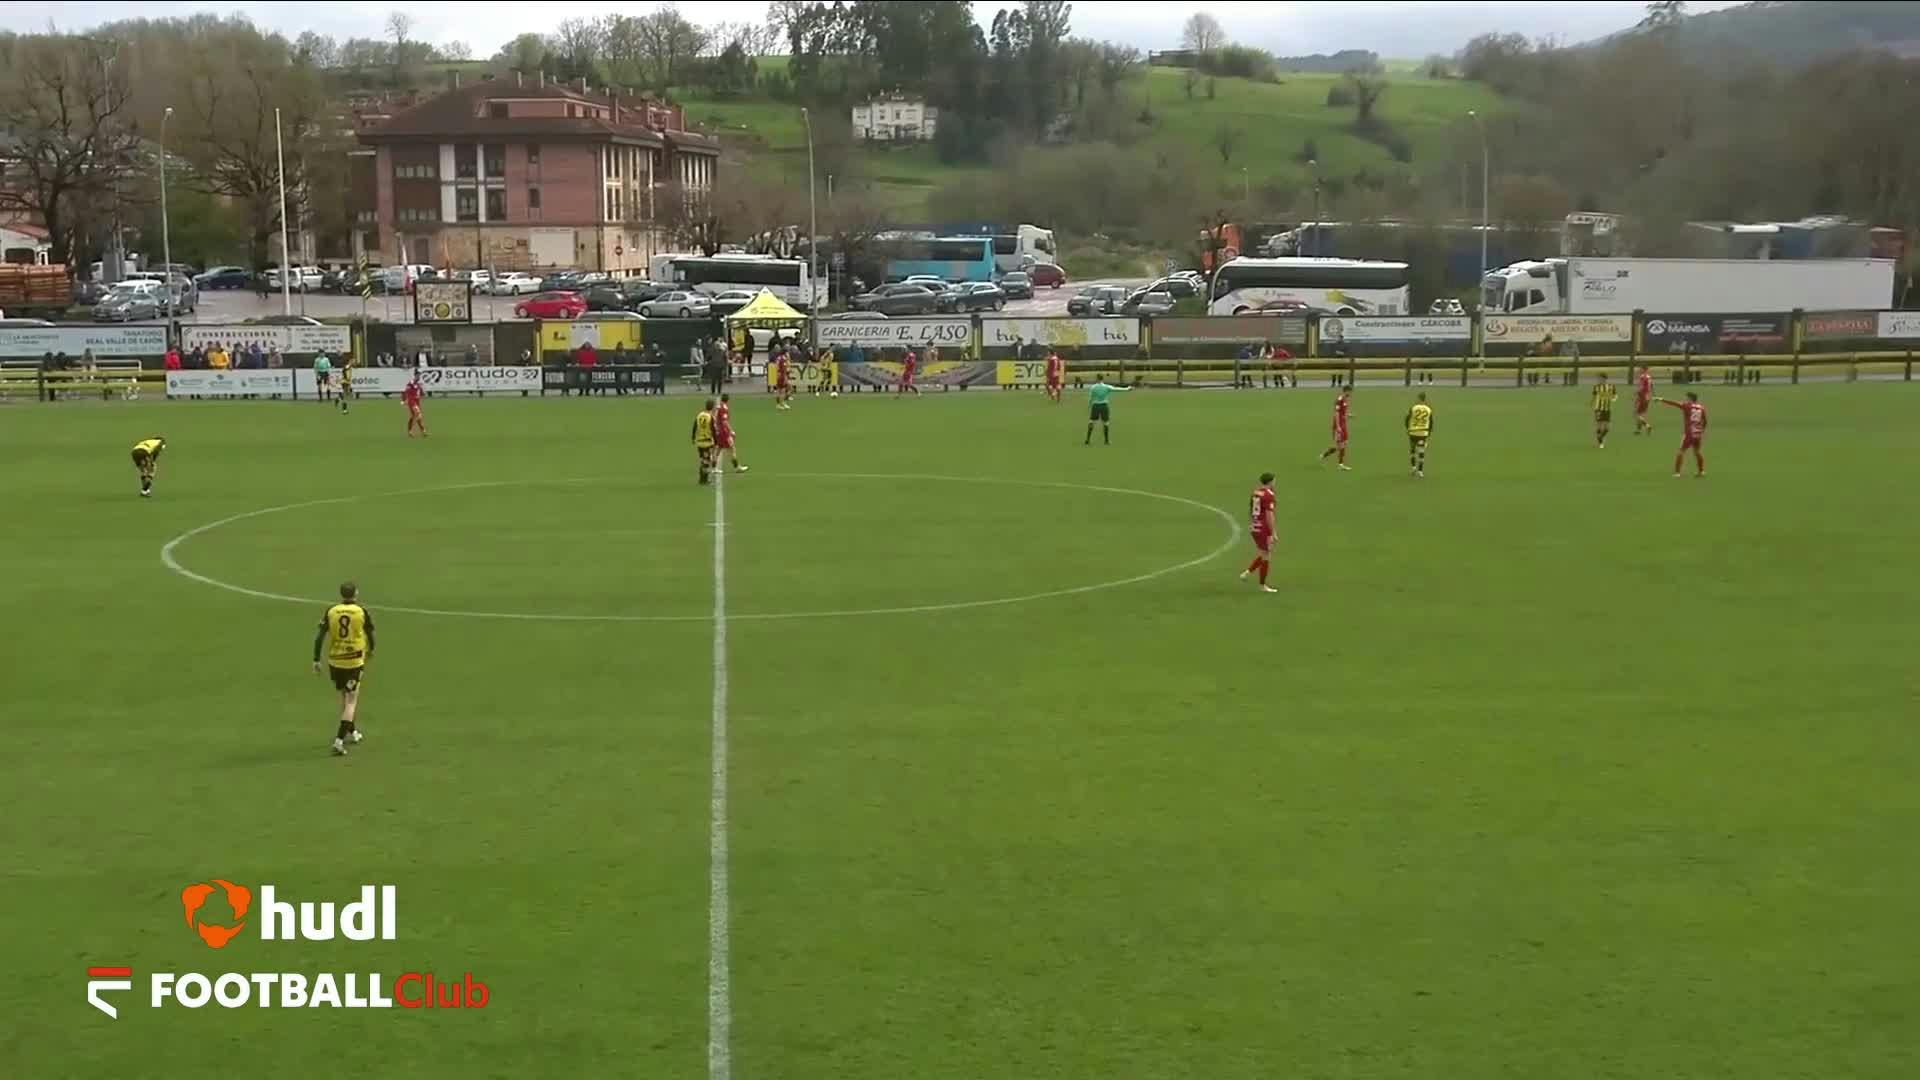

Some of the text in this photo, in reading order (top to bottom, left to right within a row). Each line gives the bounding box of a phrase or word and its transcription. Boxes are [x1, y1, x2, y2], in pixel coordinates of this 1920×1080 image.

[822, 325, 967, 341] CARNICERIA E. LASO
[1667, 324, 1710, 333] MAINSA
[445, 366, 518, 379] sañudo
[1415, 409, 1429, 421] 22
[338, 615, 350, 638] 8
